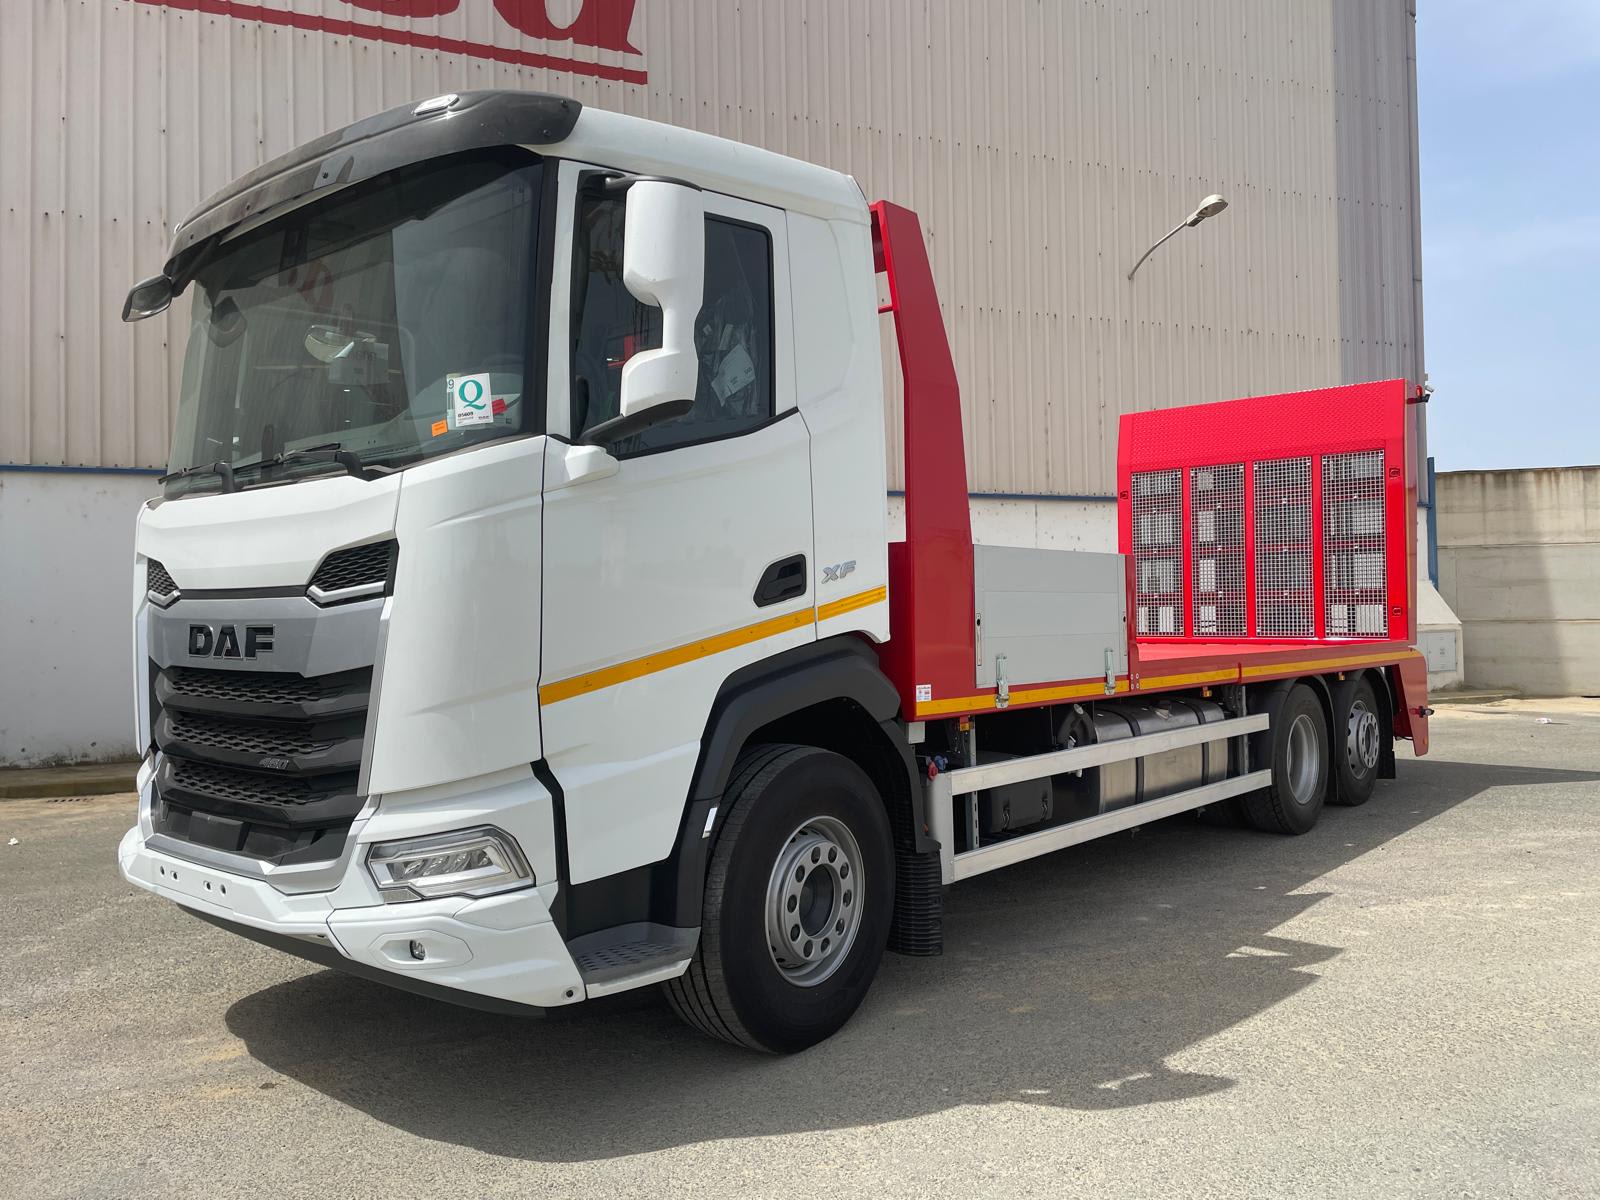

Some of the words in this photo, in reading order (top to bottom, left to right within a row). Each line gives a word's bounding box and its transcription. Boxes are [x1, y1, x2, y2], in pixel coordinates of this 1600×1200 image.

[458, 379, 487, 410] Q
[821, 560, 856, 584] XF
[188, 623, 276, 660] DAF
